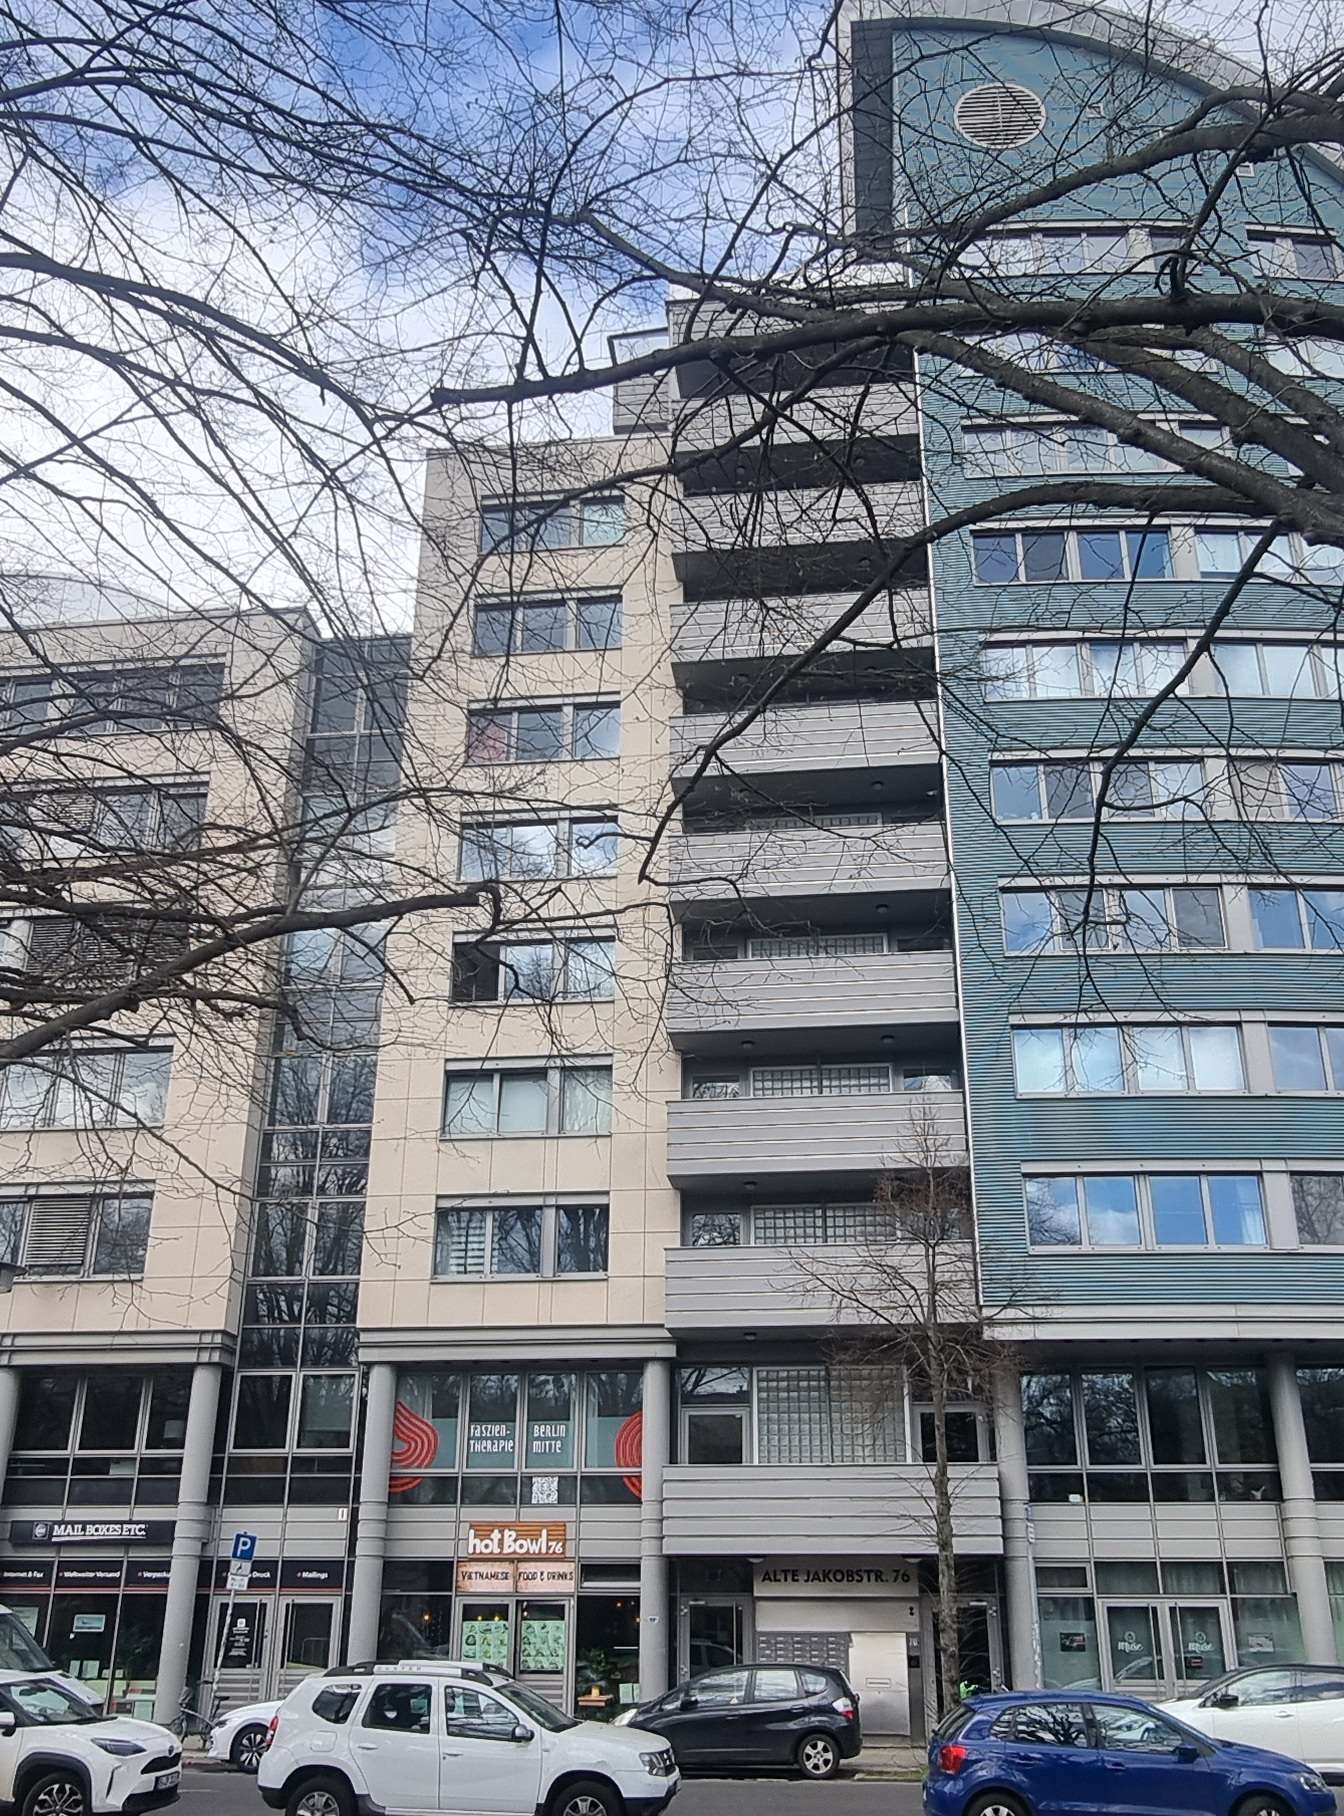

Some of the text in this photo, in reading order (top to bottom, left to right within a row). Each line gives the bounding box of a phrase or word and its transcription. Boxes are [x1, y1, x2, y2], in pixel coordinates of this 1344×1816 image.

[52, 1524, 84, 1536] MAIL
[85, 1524, 123, 1536] BOXES
[122, 1523, 146, 1535] ETC.
[237, 1537, 252, 1557] P
[548, 1542, 564, 1554] 76
[461, 1570, 510, 1581] VIETNAMESE
[518, 1570, 538, 1581] FOOD
[546, 1570, 574, 1581] DRINKS
[761, 1569, 911, 1583] ALTE JAKOBSTR. 76
